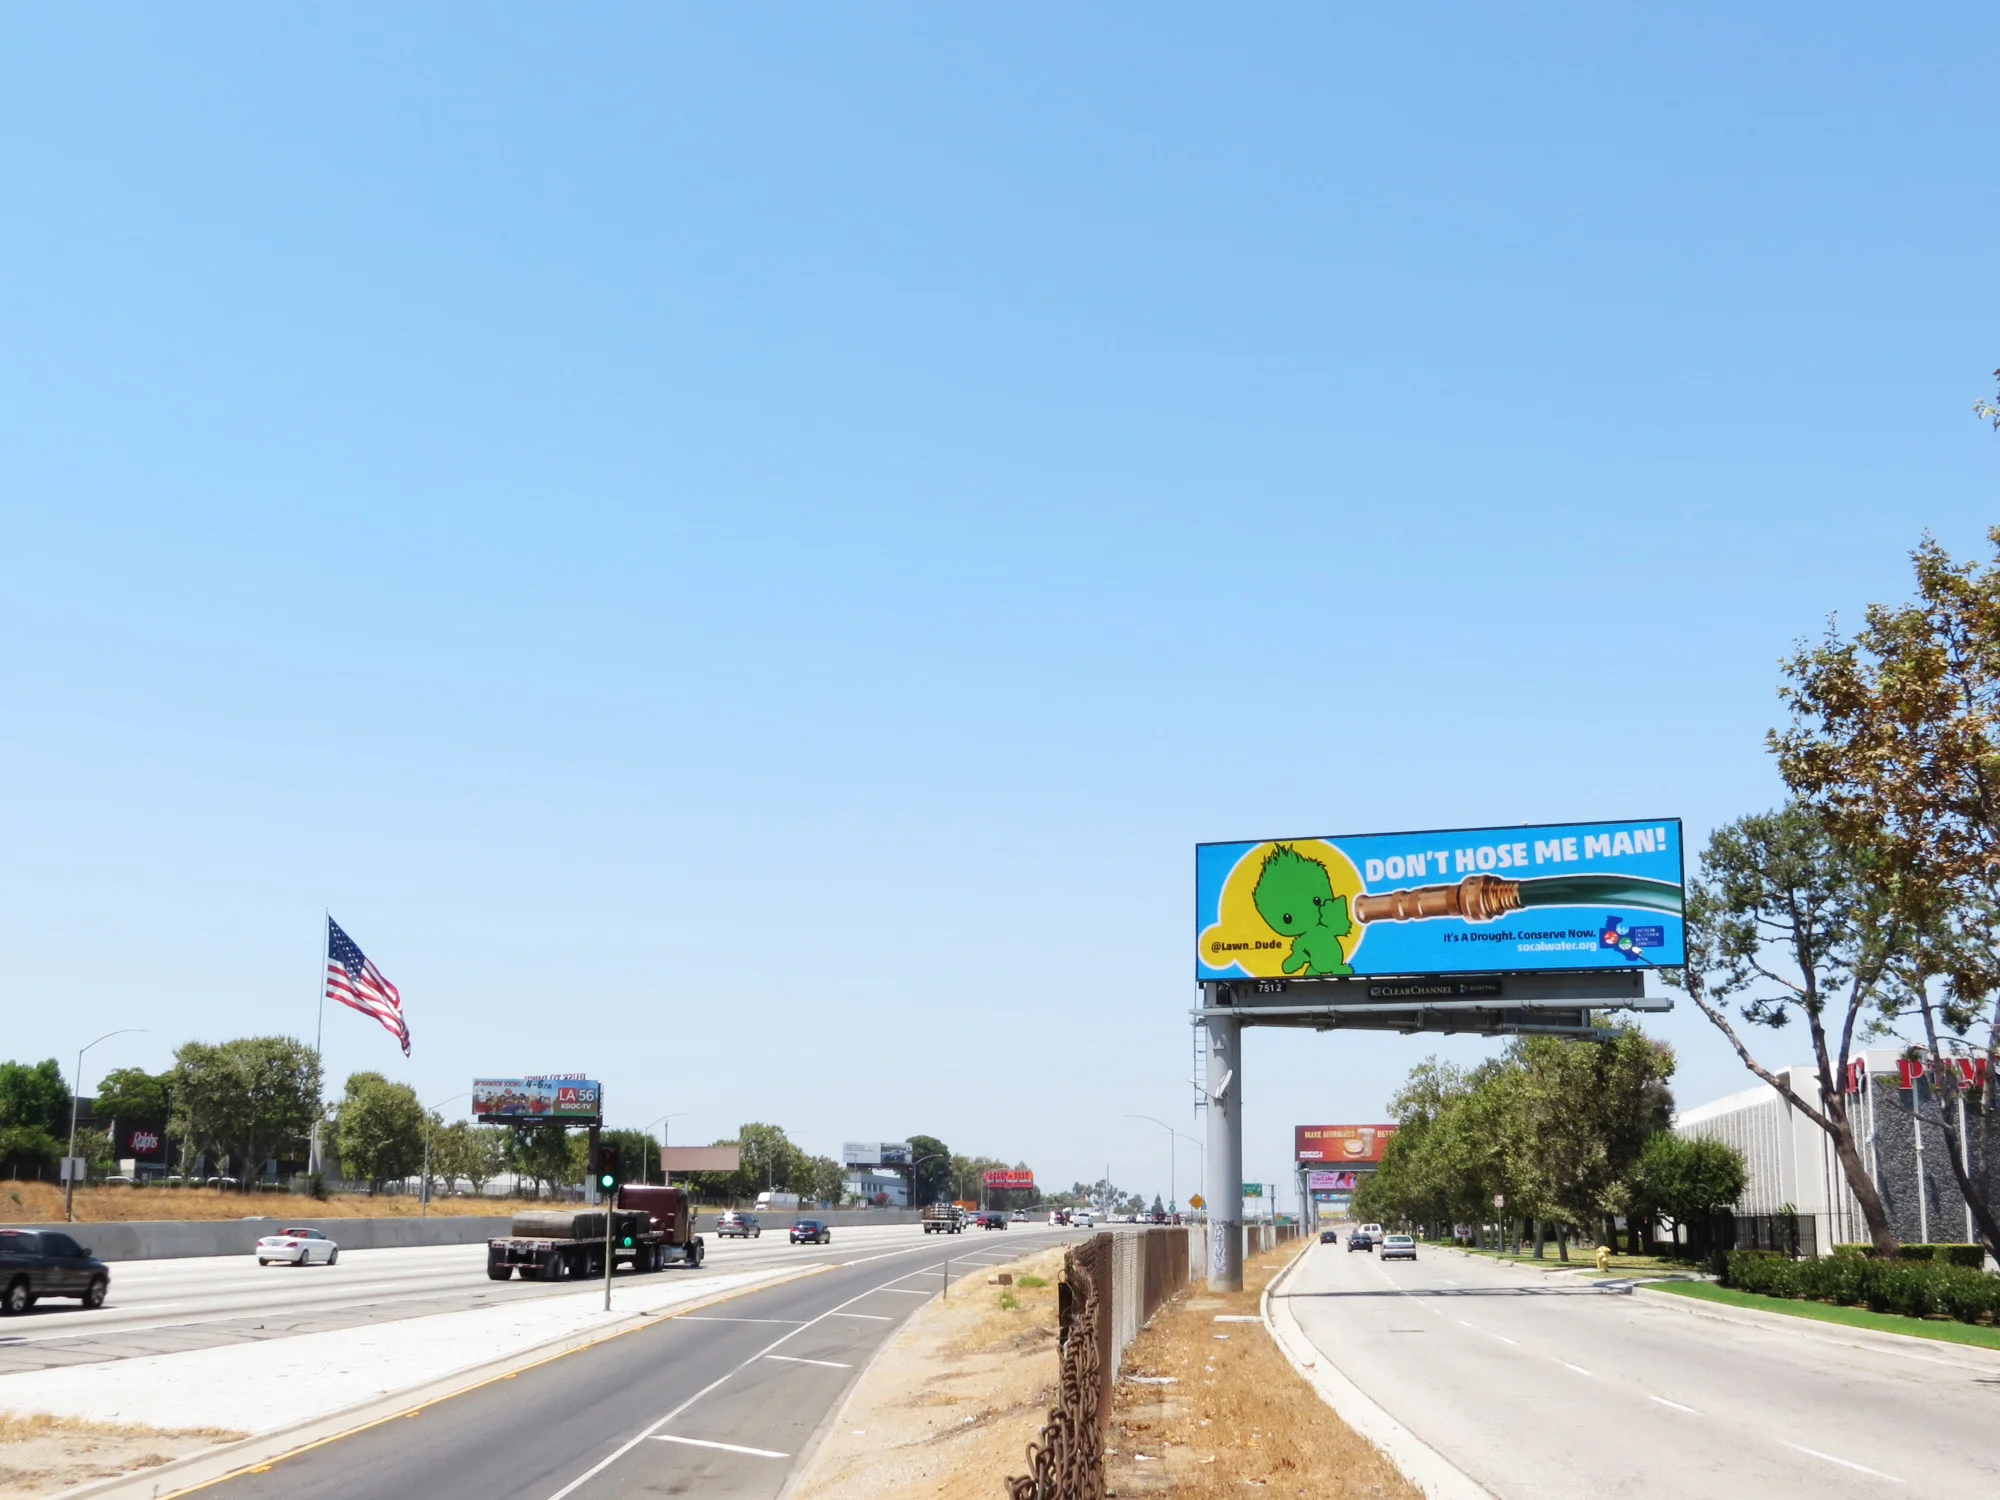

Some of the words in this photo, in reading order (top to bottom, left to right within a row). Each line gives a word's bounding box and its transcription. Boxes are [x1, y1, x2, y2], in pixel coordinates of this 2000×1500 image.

[1365, 850, 1449, 882] DON'T
[1455, 843, 1528, 873] HOSE
[1534, 836, 1578, 864] ME
[1584, 827, 1666, 859] MAN!
[1443, 932, 1459, 942] It's
[1461, 933, 1468, 941] A
[1471, 931, 1516, 943] Drought.
[1517, 930, 1566, 940] Conserve
[1568, 929, 1596, 938] Now.
[1211, 940, 1282, 953] @Lawn_Dude
[1517, 941, 1597, 952] socalwater.org
[1258, 983, 1283, 993] 7512
[559, 1089, 577, 1101] LA
[578, 1089, 595, 1102] 56
[1304, 1131, 1322, 1139] MAKE
